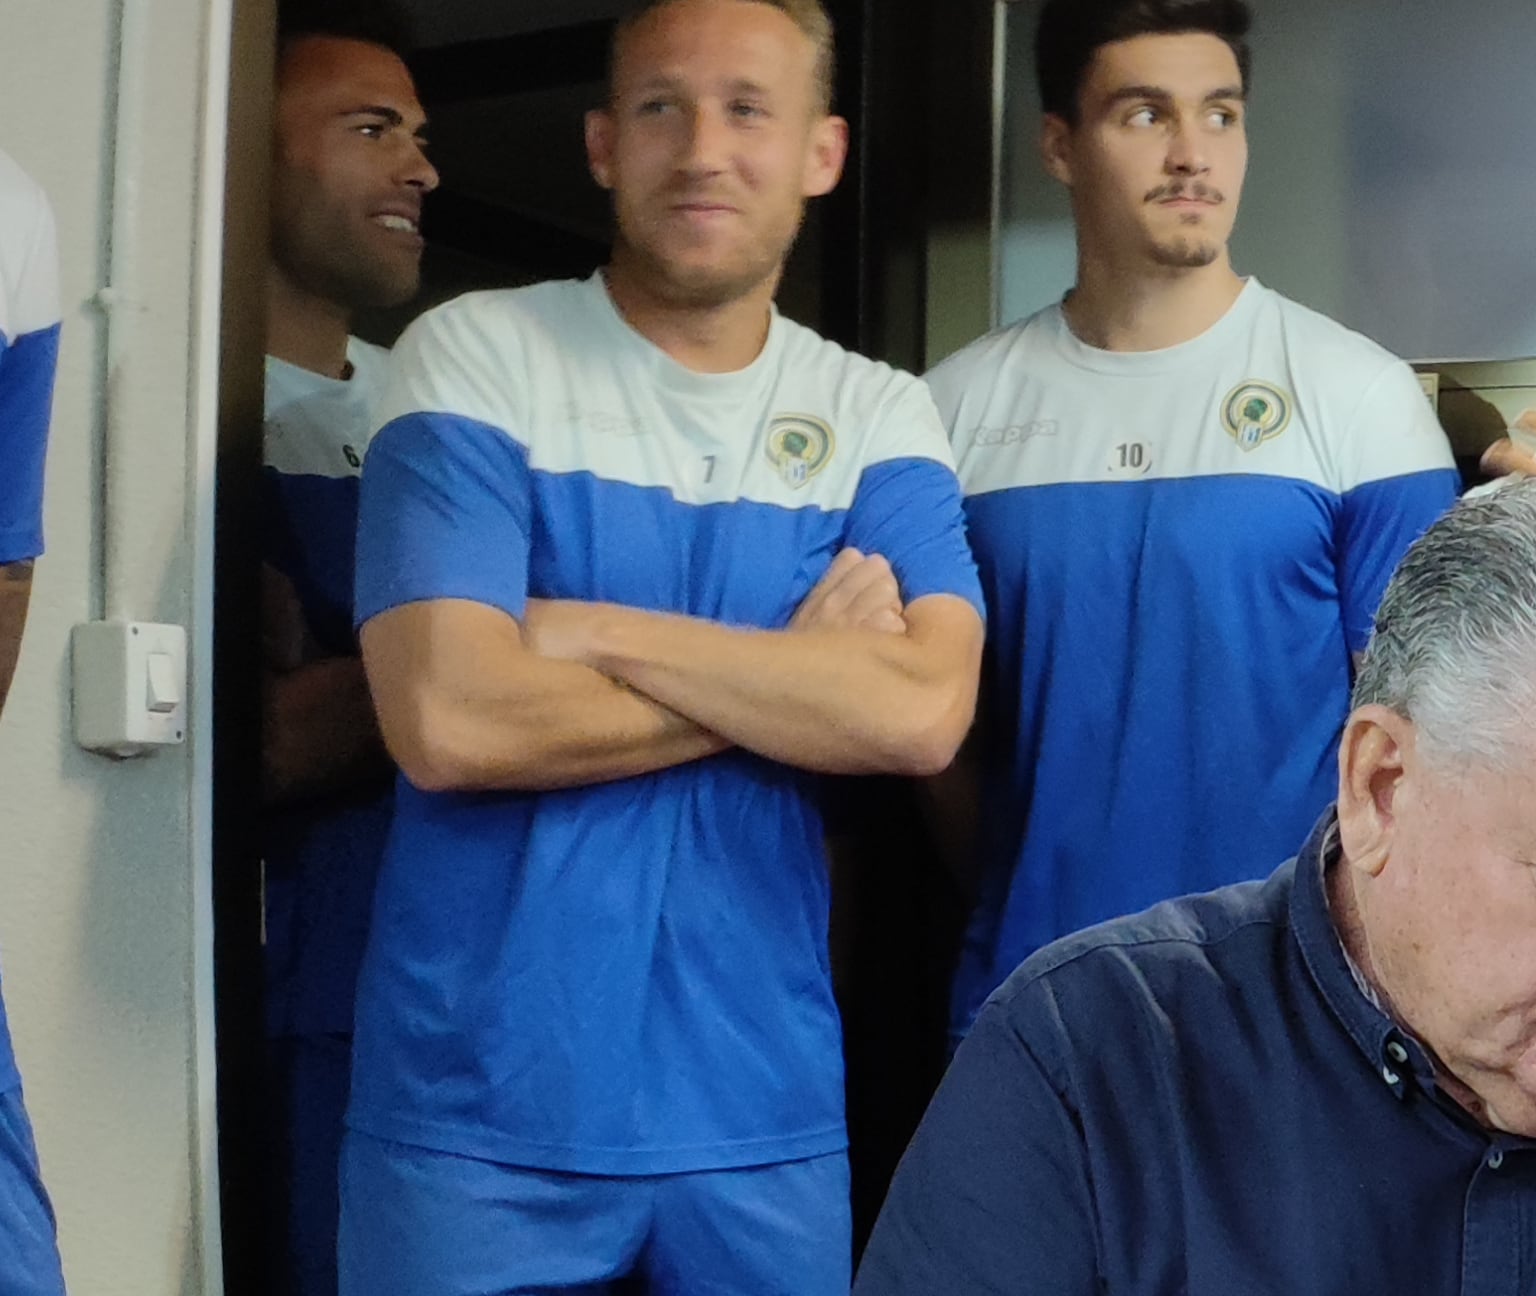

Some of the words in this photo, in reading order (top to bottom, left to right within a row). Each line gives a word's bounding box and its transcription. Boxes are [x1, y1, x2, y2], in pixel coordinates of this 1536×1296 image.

[342, 444, 360, 468] 6
[702, 455, 716, 483] 7
[1116, 442, 1143, 469] 10
